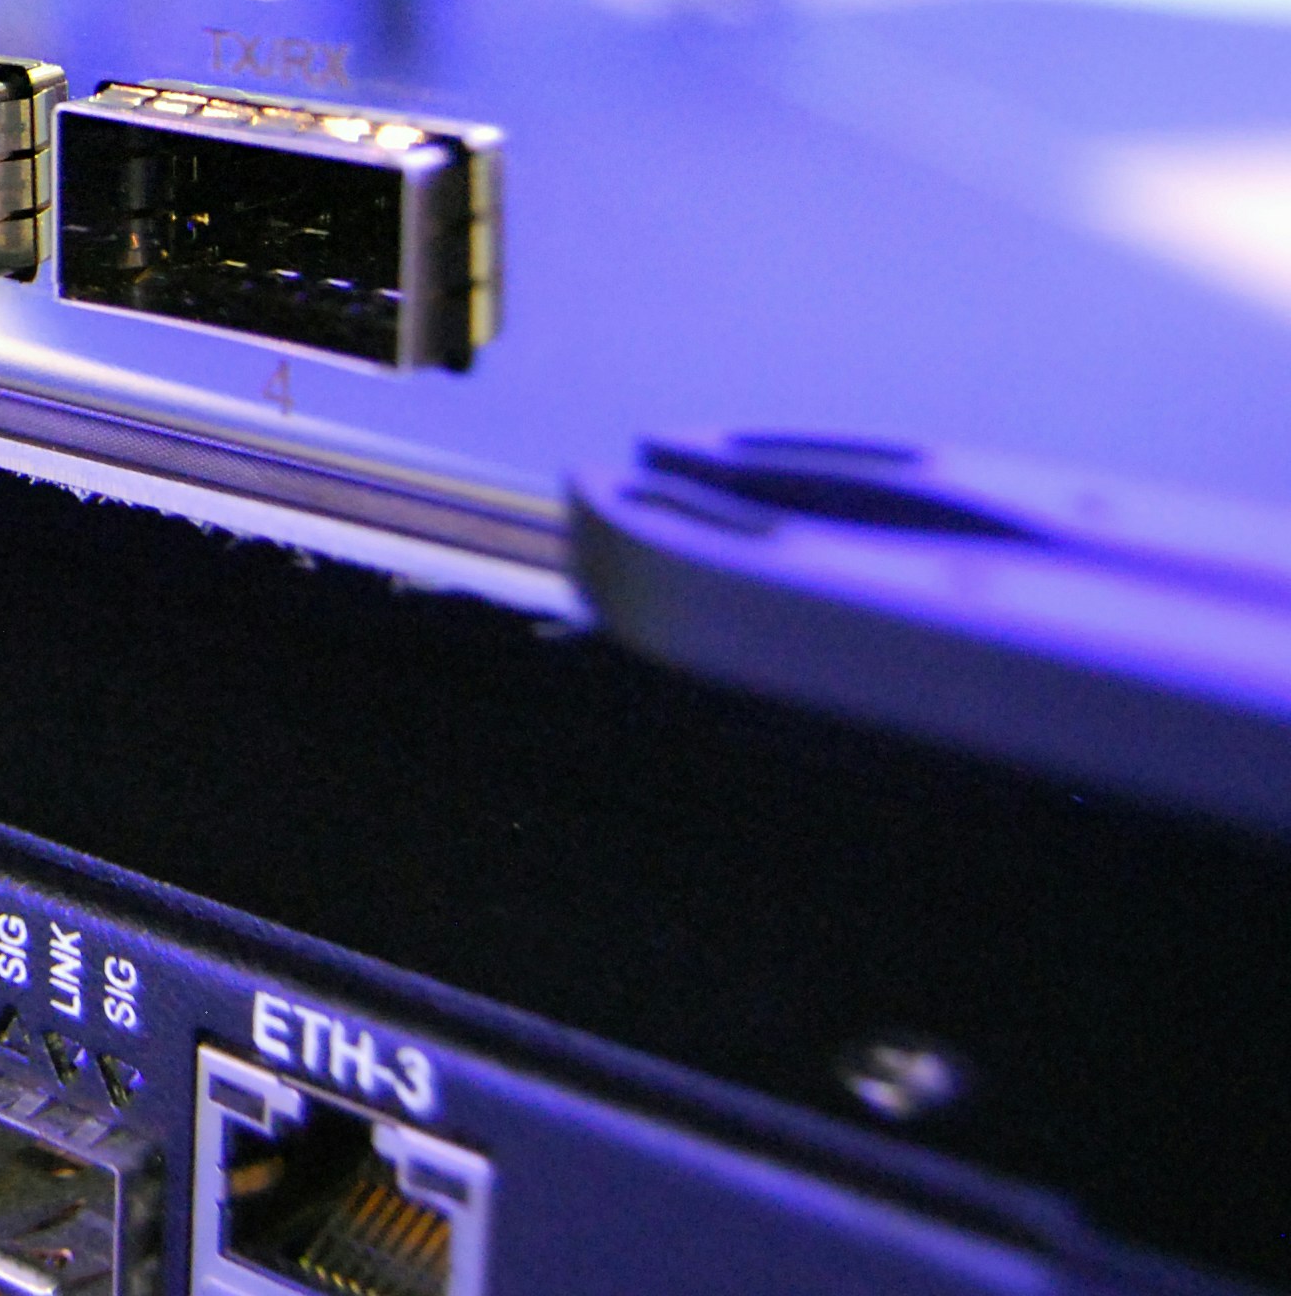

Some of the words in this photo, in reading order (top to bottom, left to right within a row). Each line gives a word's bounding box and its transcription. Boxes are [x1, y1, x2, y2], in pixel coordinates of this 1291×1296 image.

[203, 26, 351, 89] TX/RX
[263, 360, 295, 418] 4
[49, 921, 82, 1019] LINK
[103, 956, 139, 1031] SIG
